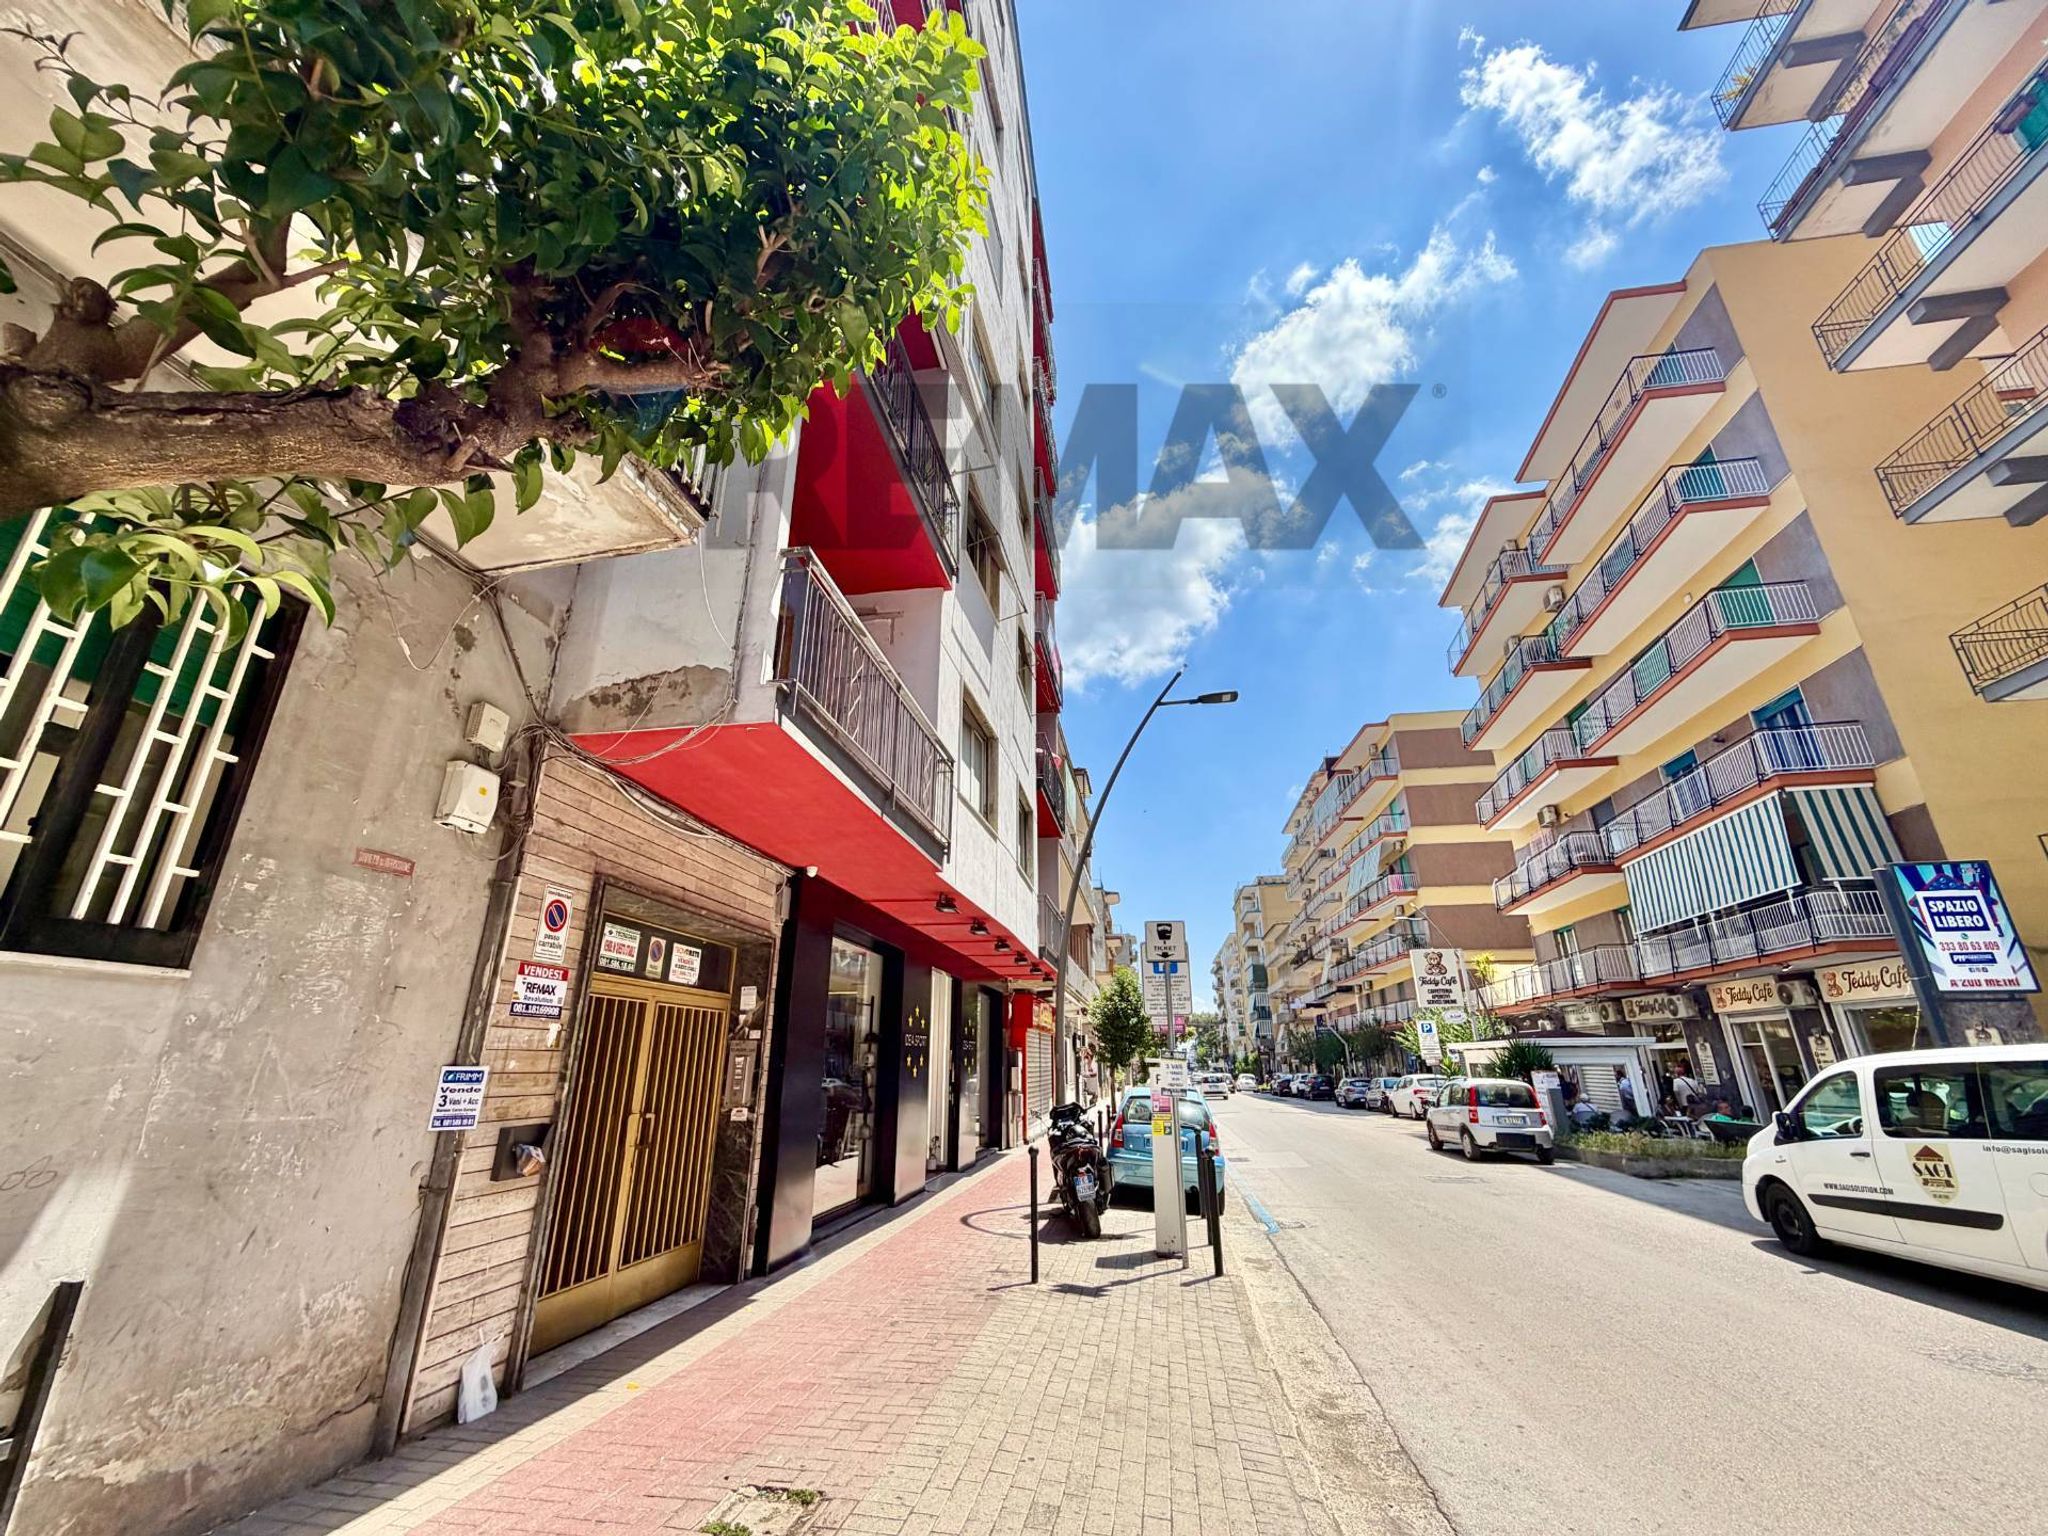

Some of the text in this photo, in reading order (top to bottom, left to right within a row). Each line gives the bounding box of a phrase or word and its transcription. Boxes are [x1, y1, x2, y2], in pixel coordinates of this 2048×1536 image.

[1928, 900, 1978, 913] SPAZIO
[1933, 915, 1984, 928] LIBERO
[1938, 941, 1957, 951] 333
[524, 964, 564, 980] VENDESI
[1419, 976, 1458, 987] Teddy Café
[1841, 965, 1909, 993] Teddy Café
[1726, 983, 1774, 1005] Teddy Café
[1635, 997, 1668, 1016] Teddy Caf
[456, 1072, 483, 1081] FRIMM
[438, 1095, 448, 1107] 3
[1912, 1162, 1954, 1179] SAGI
[1823, 1182, 1894, 1195] WWW.SAGISOLUTION.COM
